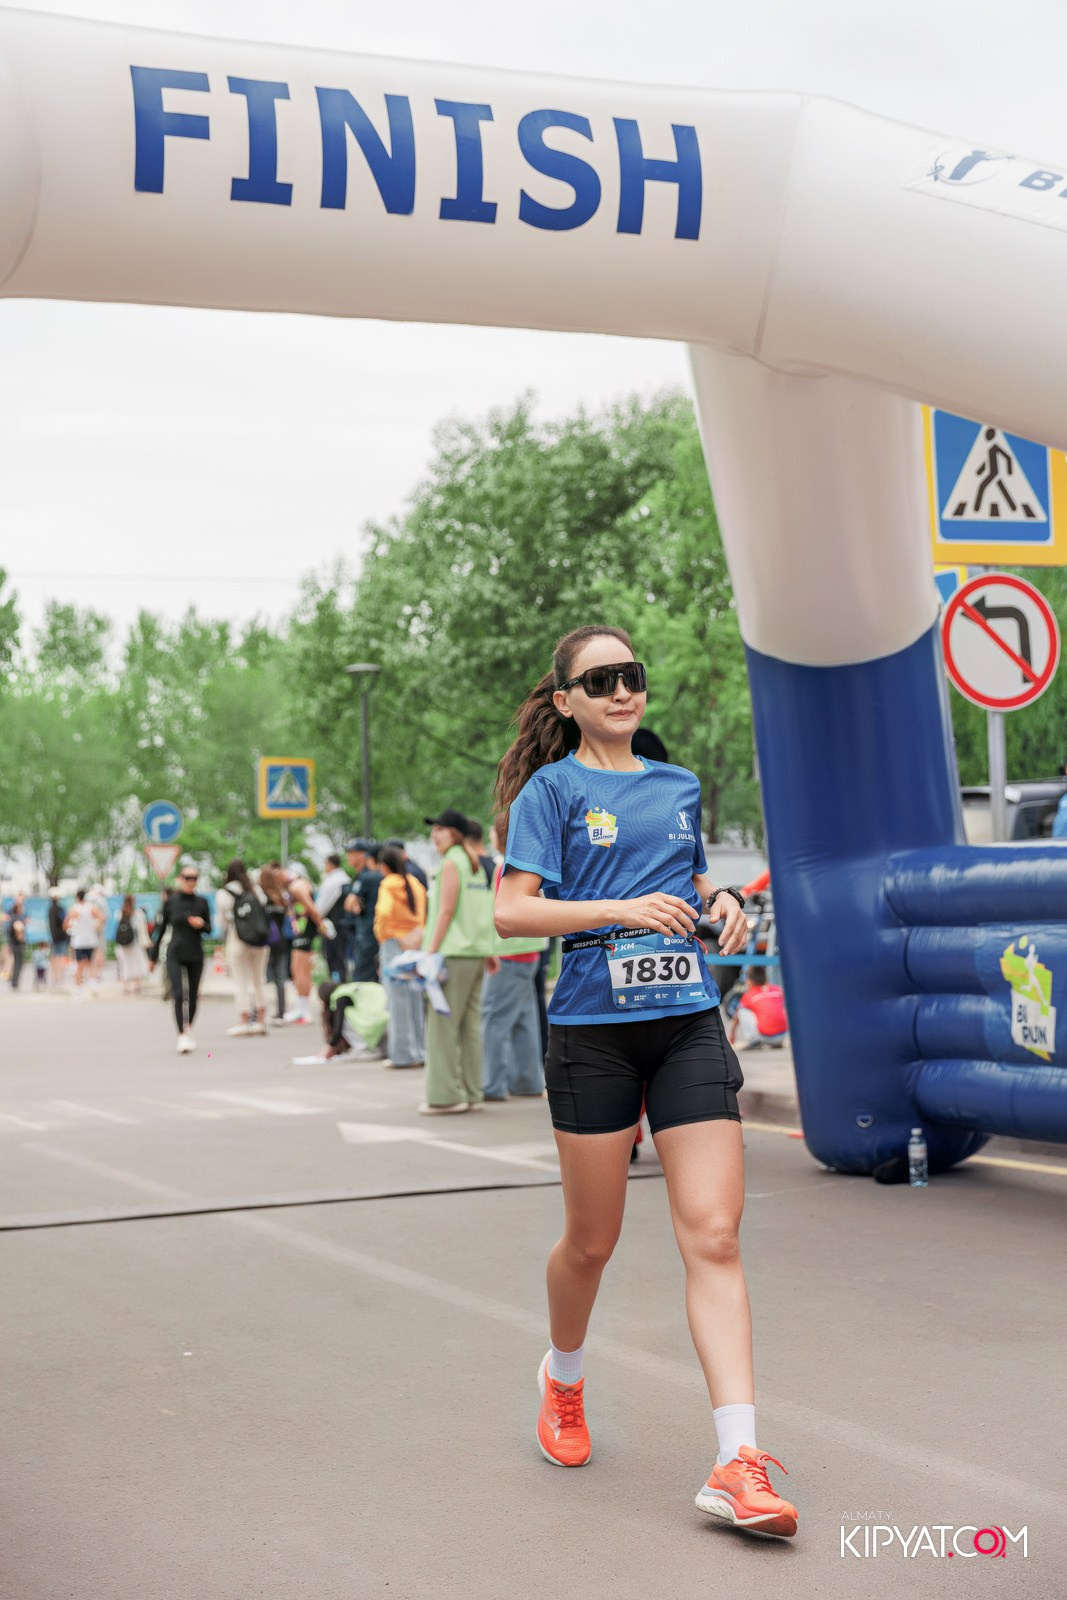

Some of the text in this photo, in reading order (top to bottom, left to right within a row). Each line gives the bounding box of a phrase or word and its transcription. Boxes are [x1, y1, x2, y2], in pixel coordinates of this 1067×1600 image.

[130, 65, 703, 241] FINISH
[1018, 170, 1067, 199] B
[593, 828, 603, 837] BI
[620, 942, 635, 951] KM
[622, 956, 691, 984] 1830
